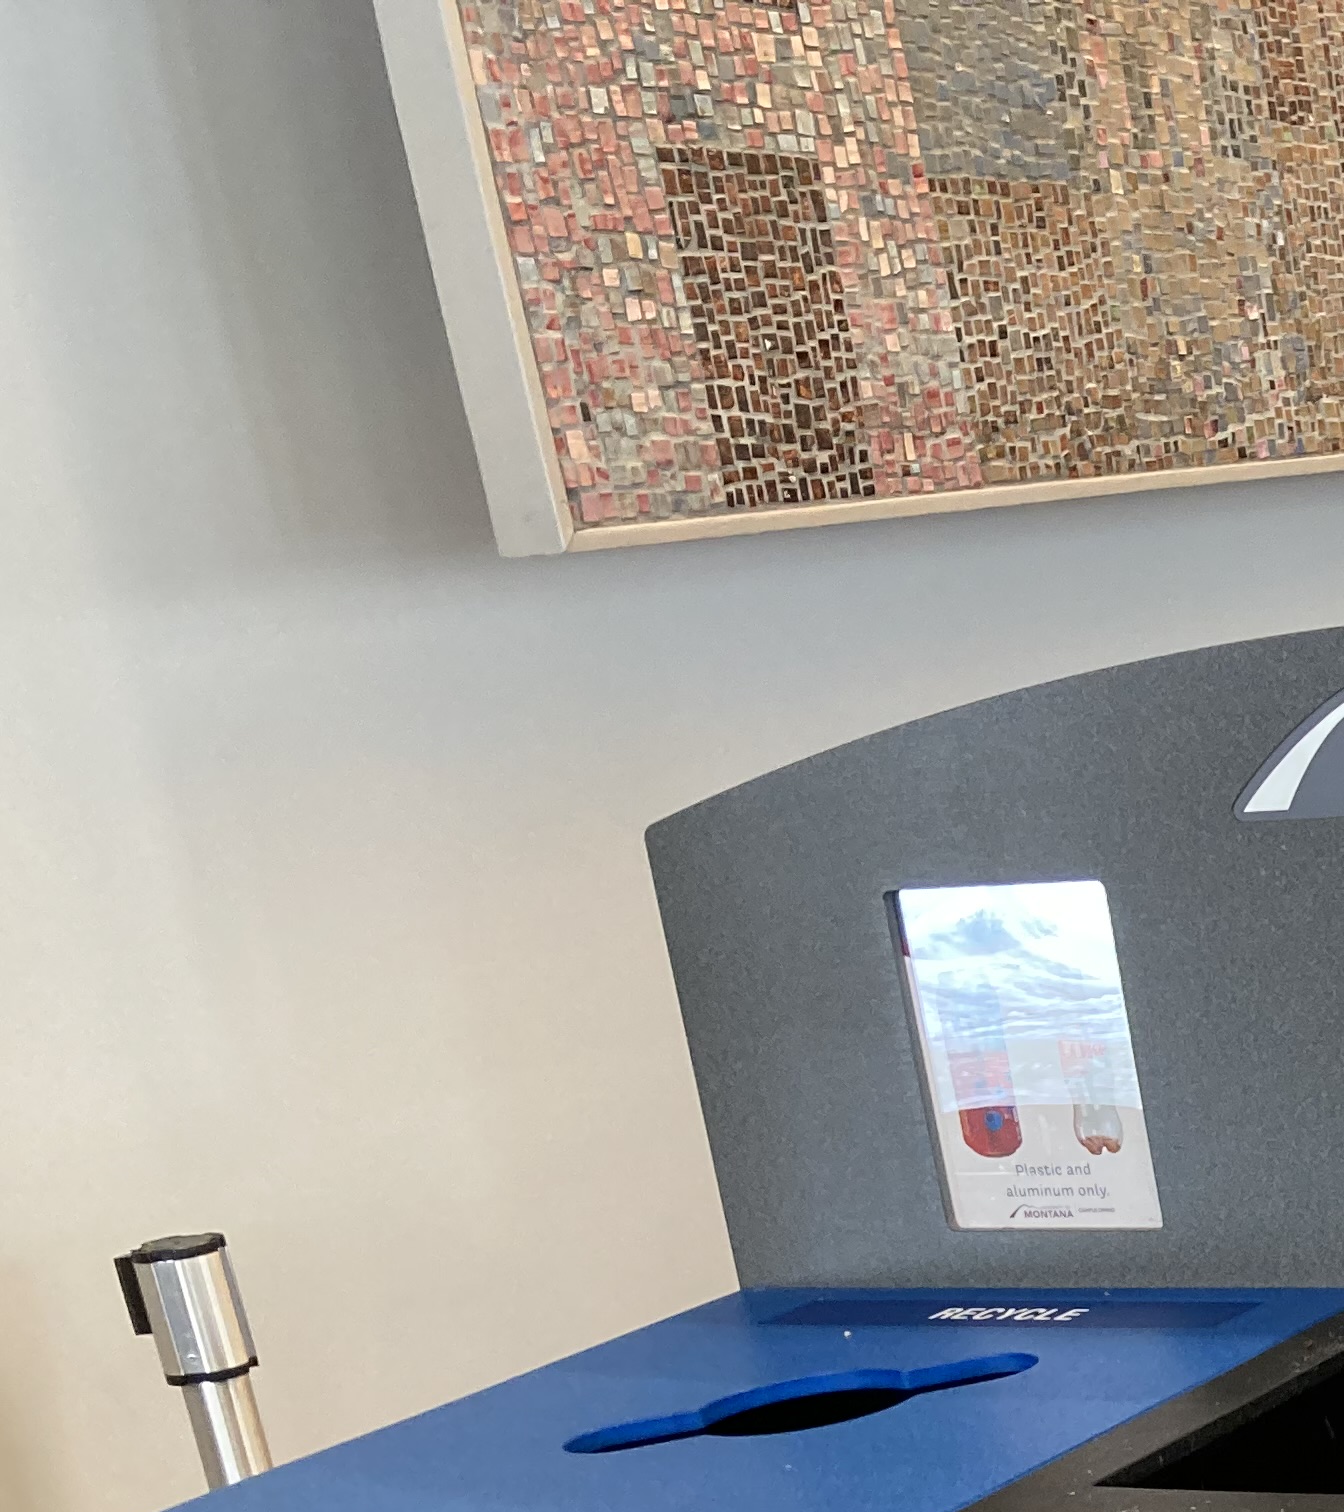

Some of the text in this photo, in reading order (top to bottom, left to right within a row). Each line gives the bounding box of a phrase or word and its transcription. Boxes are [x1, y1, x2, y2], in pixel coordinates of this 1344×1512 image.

[1015, 1162, 1091, 1177] Plastic and
[1006, 1183, 1110, 1199] aluminum only.
[1024, 1209, 1074, 1219] MONTANA
[928, 1307, 1089, 1321] RECYCLE
